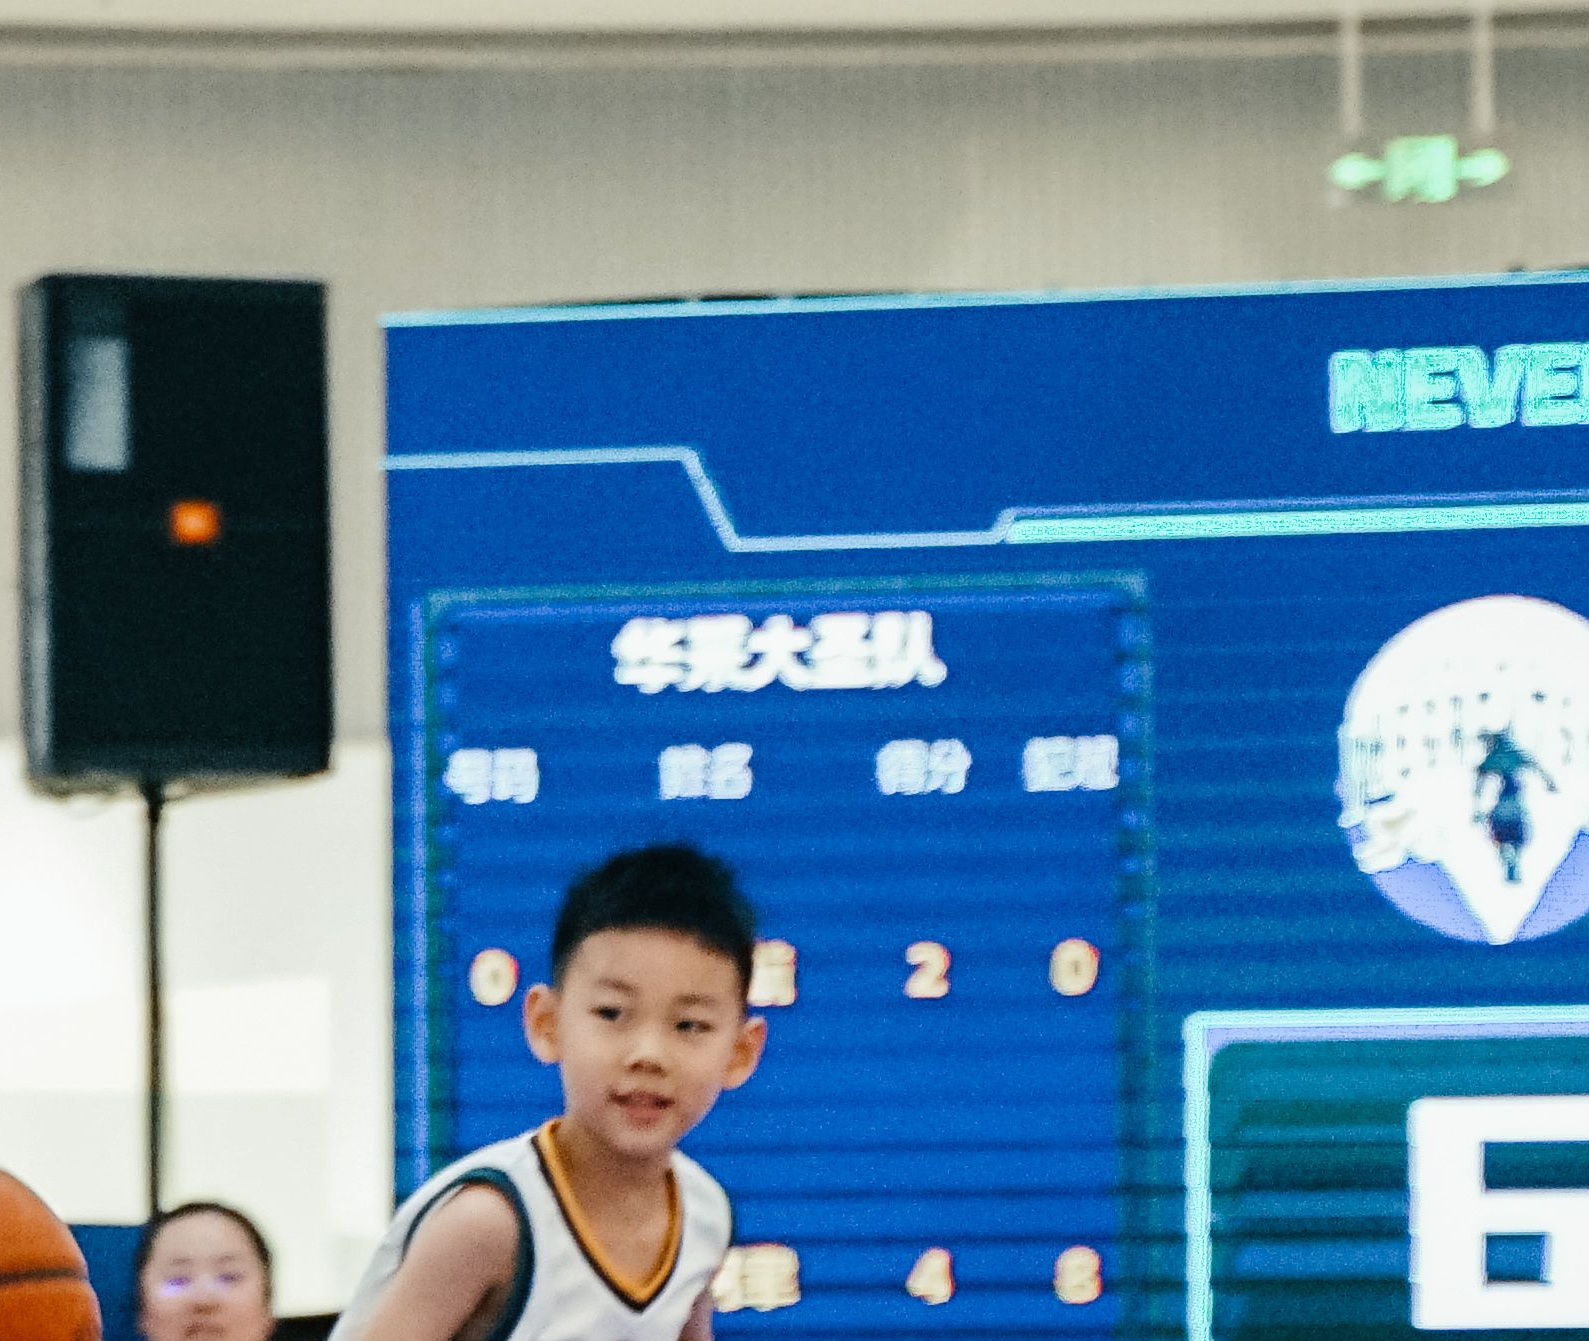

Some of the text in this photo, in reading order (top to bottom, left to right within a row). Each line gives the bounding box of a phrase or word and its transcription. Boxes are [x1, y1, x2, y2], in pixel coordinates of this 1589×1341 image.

[1328, 341, 1589, 434] NEVE
[903, 941, 950, 999] 2
[1049, 937, 1100, 995] 0
[906, 1247, 955, 1304] 4
